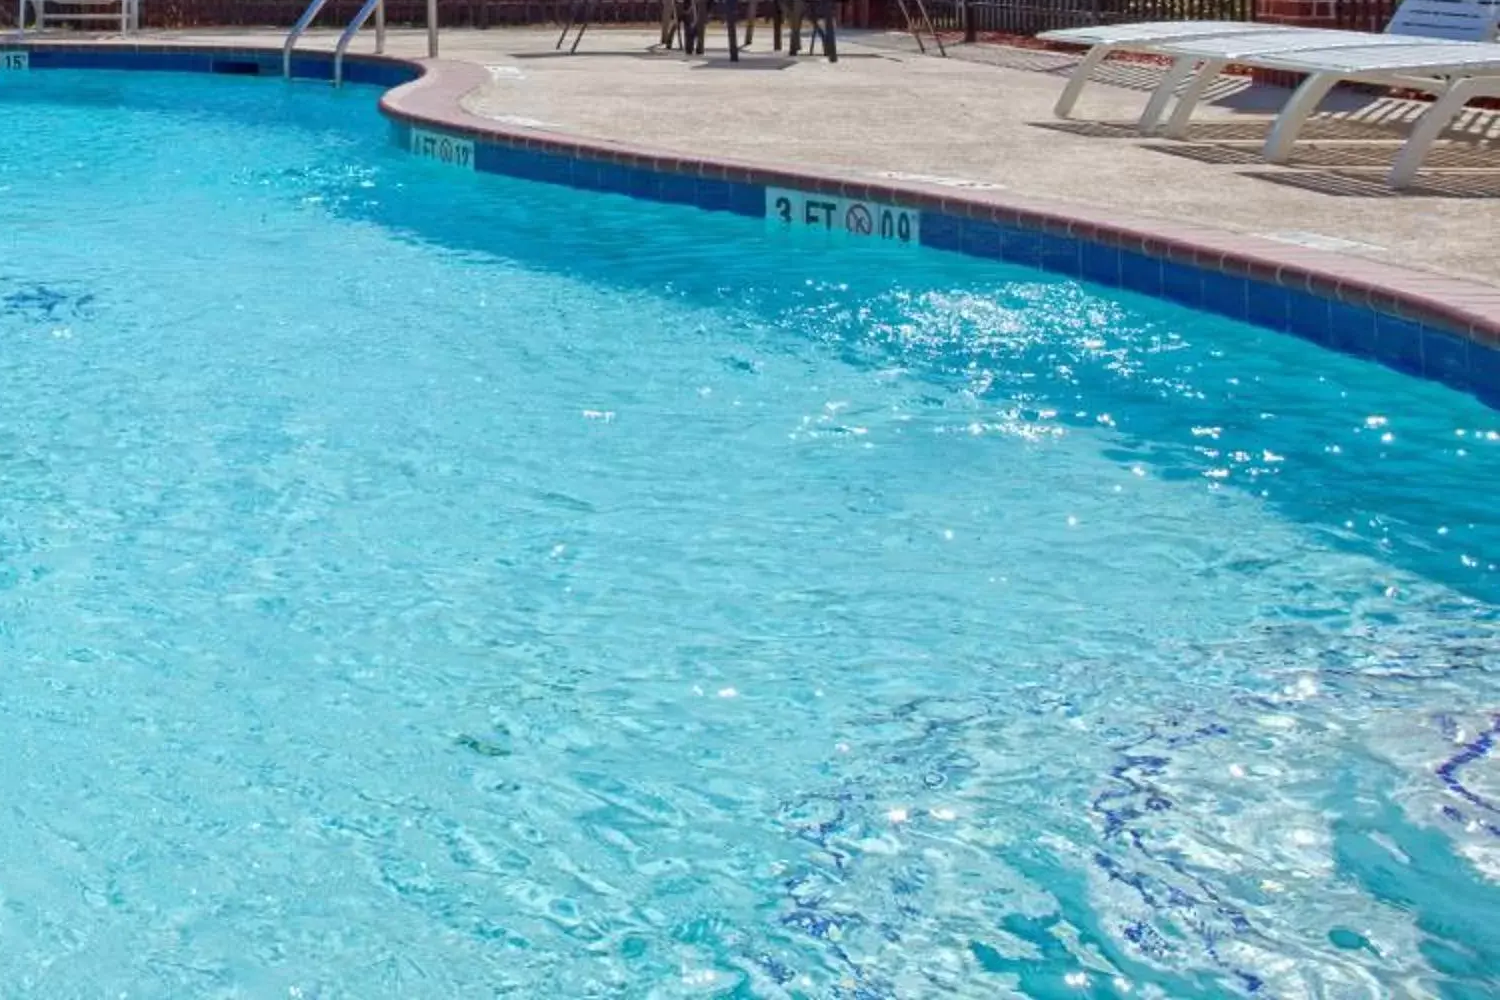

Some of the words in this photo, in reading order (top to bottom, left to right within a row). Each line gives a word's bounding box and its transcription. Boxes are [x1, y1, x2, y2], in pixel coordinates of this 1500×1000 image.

[5, 55, 23, 70] 15
[775, 196, 793, 223] 3
[805, 200, 837, 231] FT
